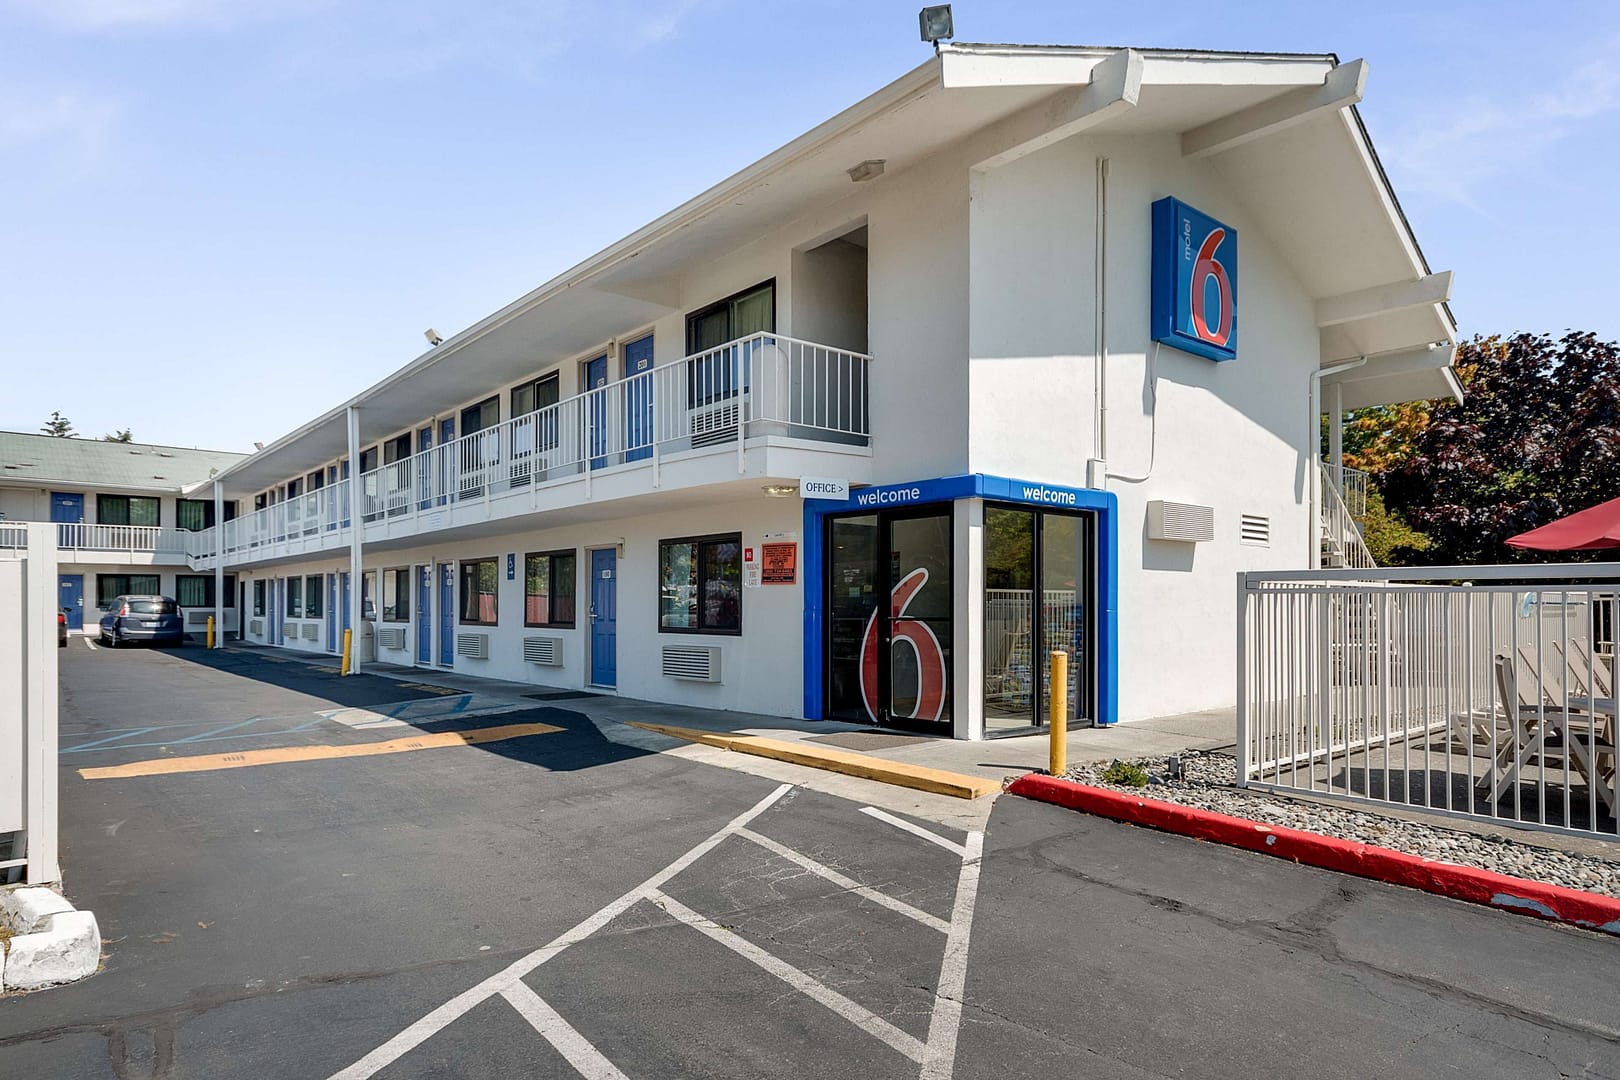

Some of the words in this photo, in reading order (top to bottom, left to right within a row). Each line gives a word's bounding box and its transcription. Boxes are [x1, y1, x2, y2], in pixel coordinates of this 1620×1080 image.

[1183, 218, 1191, 261] motel
[1190, 228, 1233, 346] 6
[805, 482, 836, 493] OFFICE
[858, 488, 920, 505] welcome
[1023, 485, 1076, 505] welcome
[859, 567, 946, 722] 6
